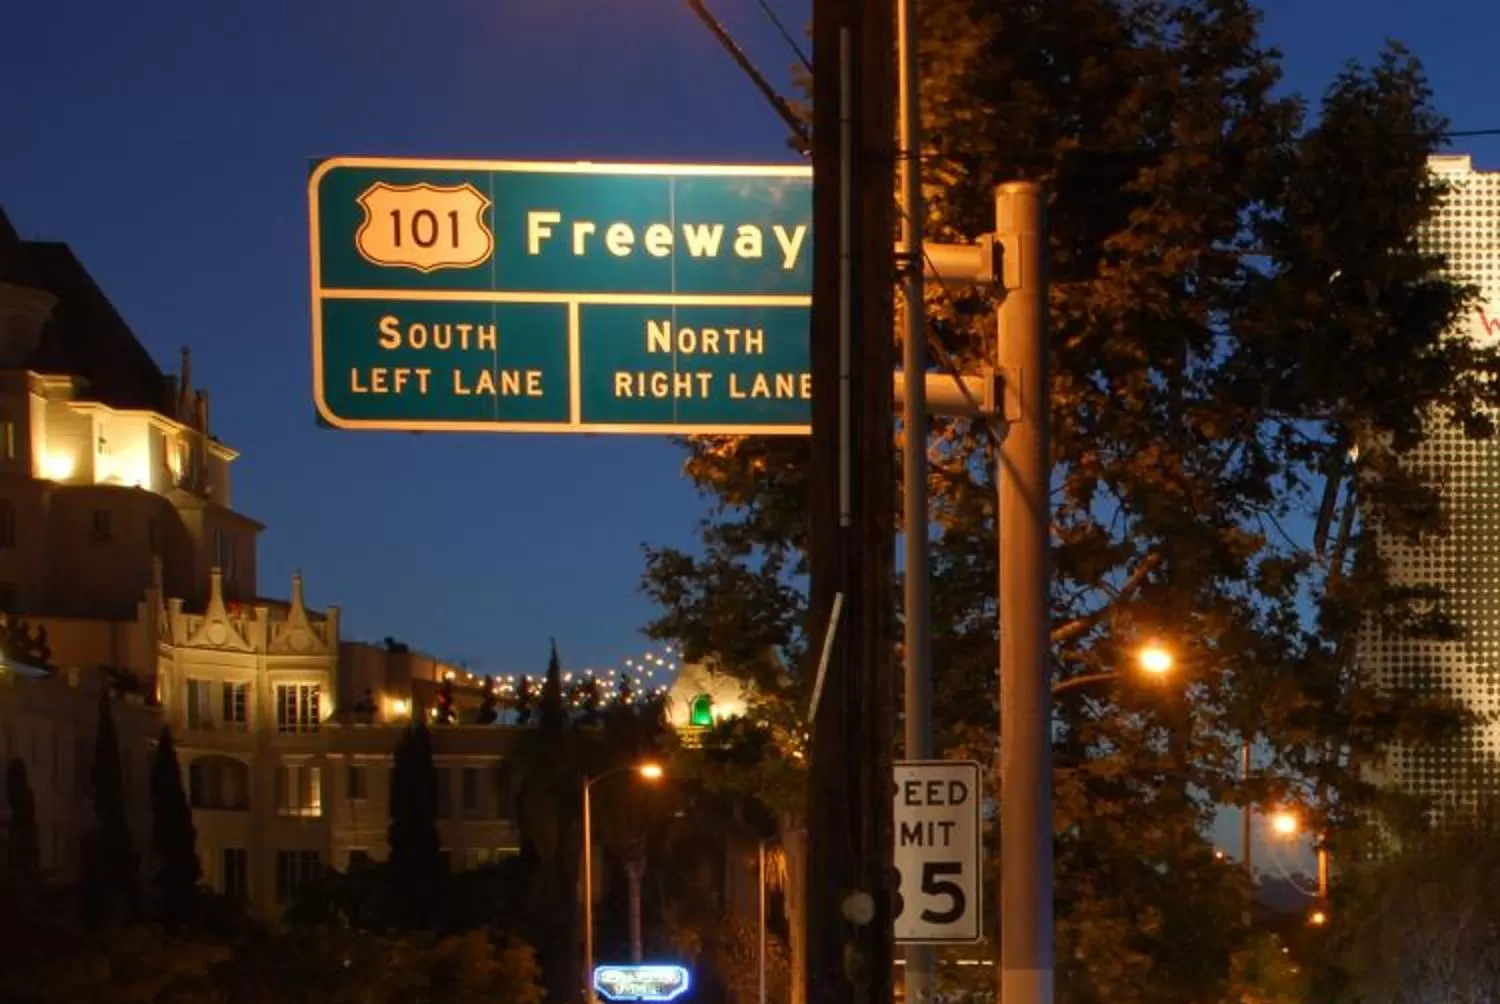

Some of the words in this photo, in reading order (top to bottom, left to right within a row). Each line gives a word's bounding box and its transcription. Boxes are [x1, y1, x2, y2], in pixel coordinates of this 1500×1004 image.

[389, 208, 460, 250] 101
[526, 210, 807, 270] Freeway
[377, 314, 498, 351] SOUTH
[645, 318, 765, 354] NORTH
[350, 366, 431, 395] LEFT
[453, 368, 544, 396] LANE
[614, 370, 713, 398] RIGHT
[728, 371, 812, 400] LANE
[894, 779, 968, 807] EED
[900, 820, 956, 847] MIT
[894, 860, 967, 925] 5
